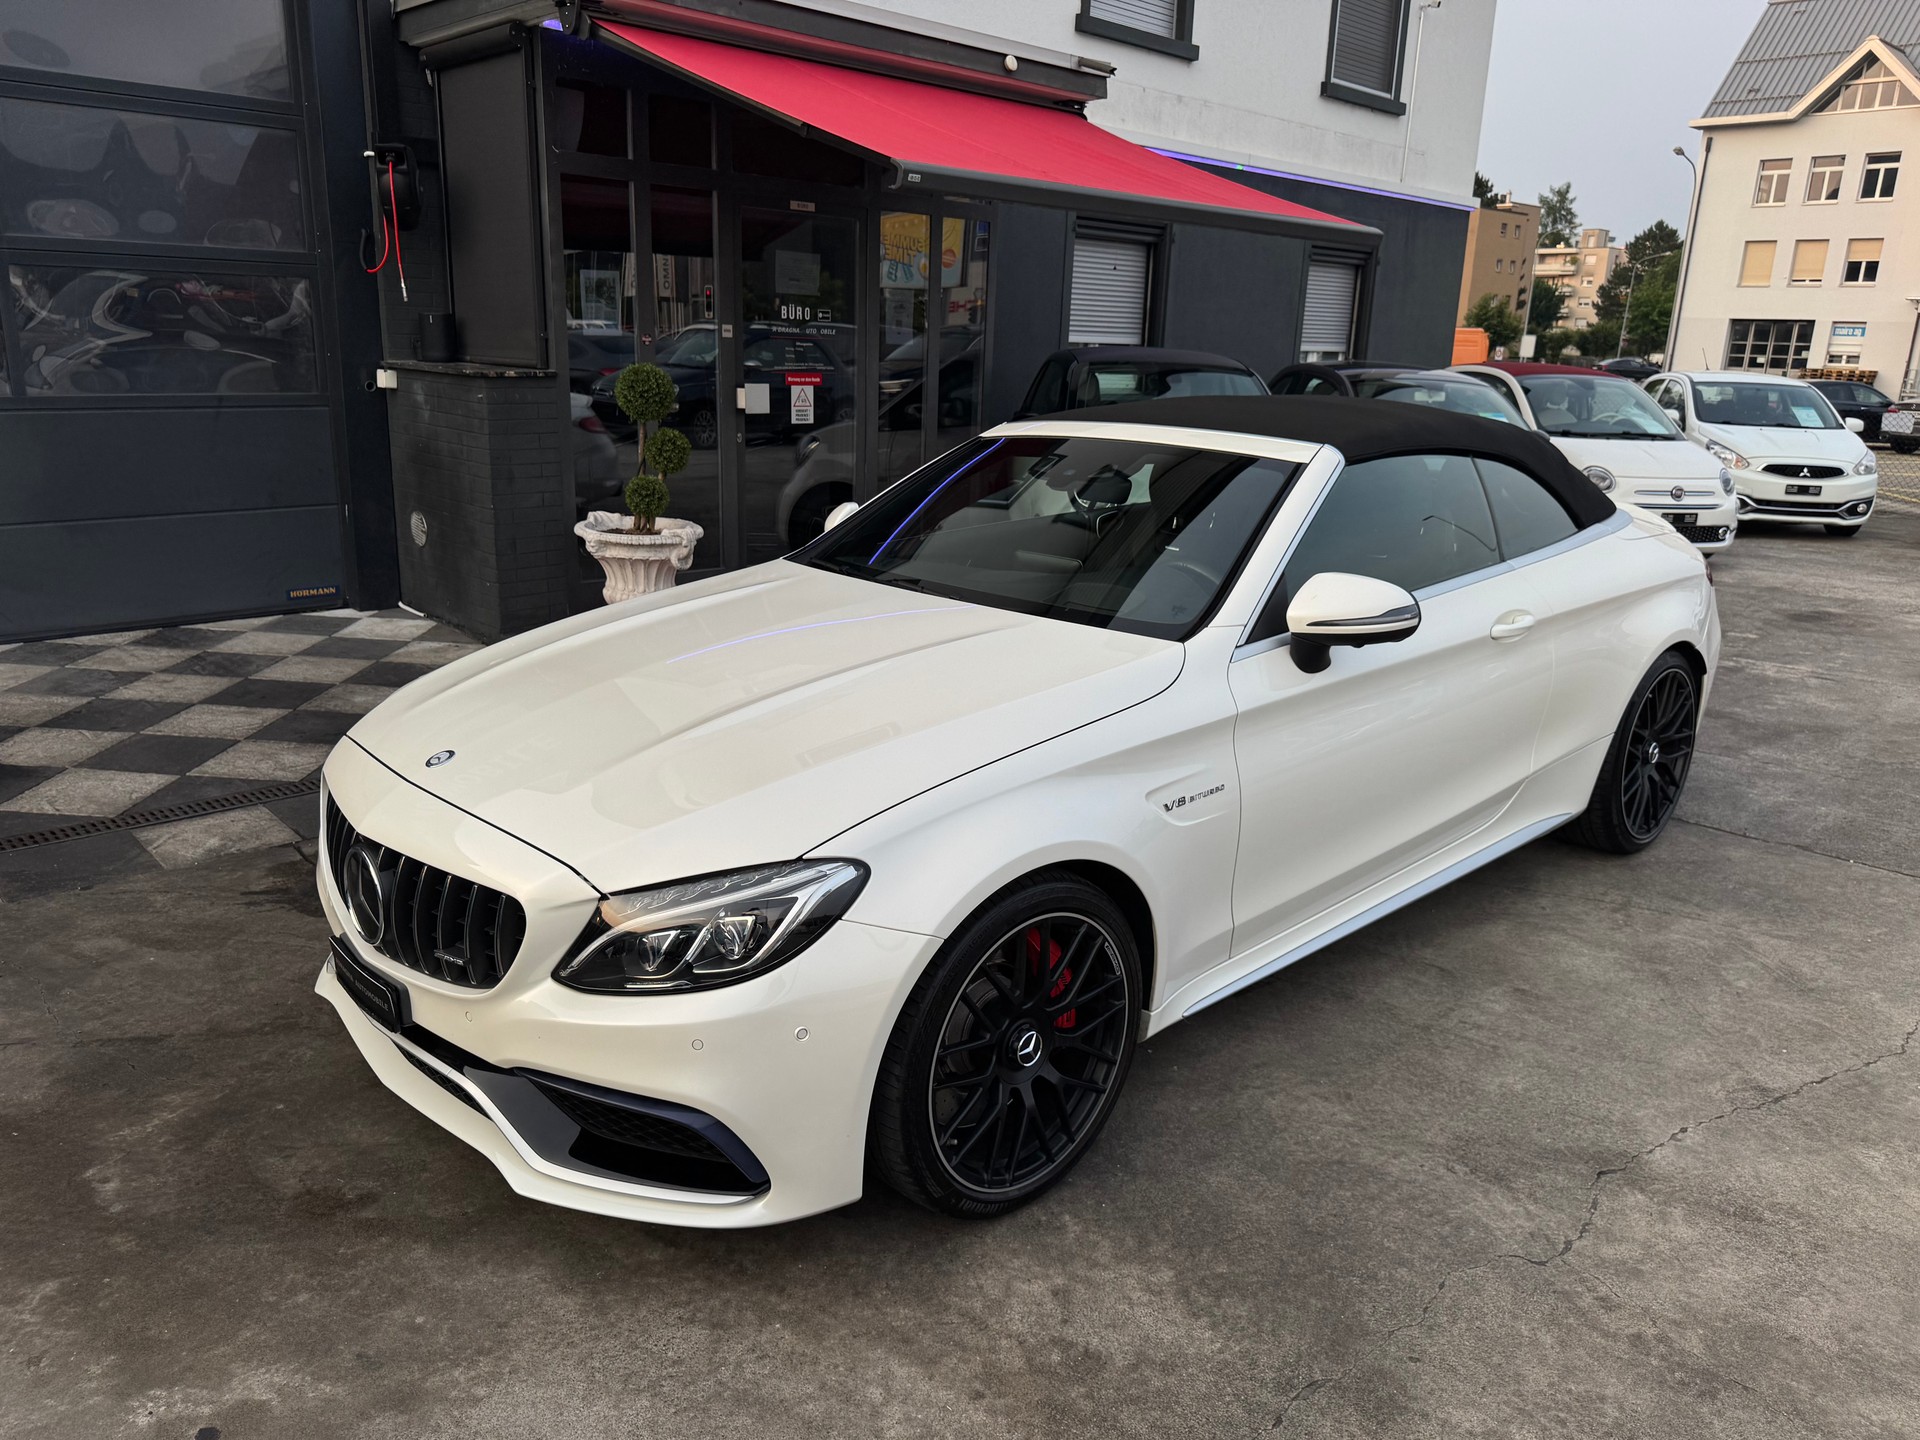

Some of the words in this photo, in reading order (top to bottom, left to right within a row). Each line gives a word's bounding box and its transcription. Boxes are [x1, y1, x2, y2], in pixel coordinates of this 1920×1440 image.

[781, 303, 810, 320] BÜRO
[1163, 796, 1186, 812] V8
[1188, 783, 1225, 803] BITURBO
